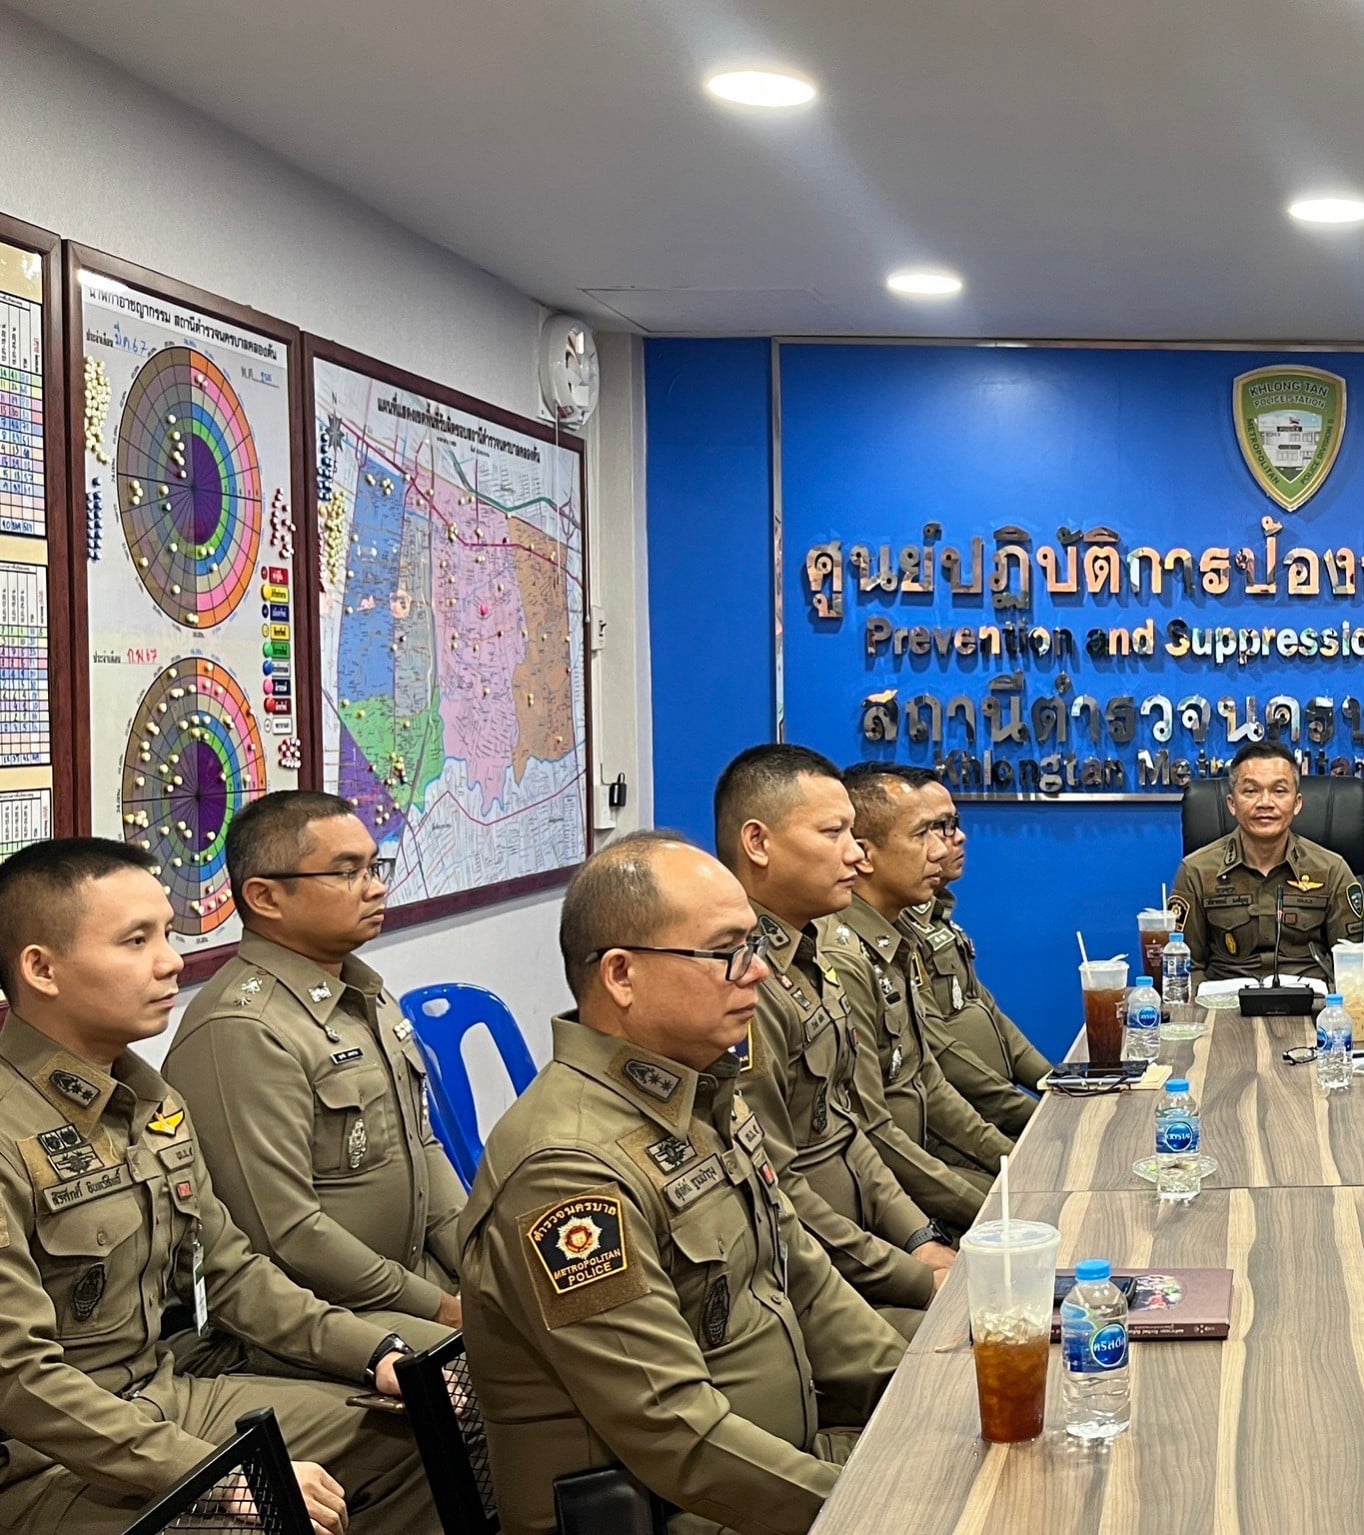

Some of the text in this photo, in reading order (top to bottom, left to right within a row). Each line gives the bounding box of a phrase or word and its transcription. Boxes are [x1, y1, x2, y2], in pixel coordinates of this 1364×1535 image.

[1250, 381, 1329, 397] KHLONG TAN
[1254, 394, 1326, 409] POLICE STATION
[1247, 418, 1281, 485] METROPOLITAN
[1300, 459, 1321, 486] POLICE
[866, 616, 1073, 657] Prevention
[1086, 618, 1155, 657] and
[935, 750, 1124, 793] Khlongtan
[533, 1202, 617, 1242] ตำรวจนครบาล
[553, 1248, 622, 1280] METROPOLITAN
[568, 1261, 613, 1286] POLICE
